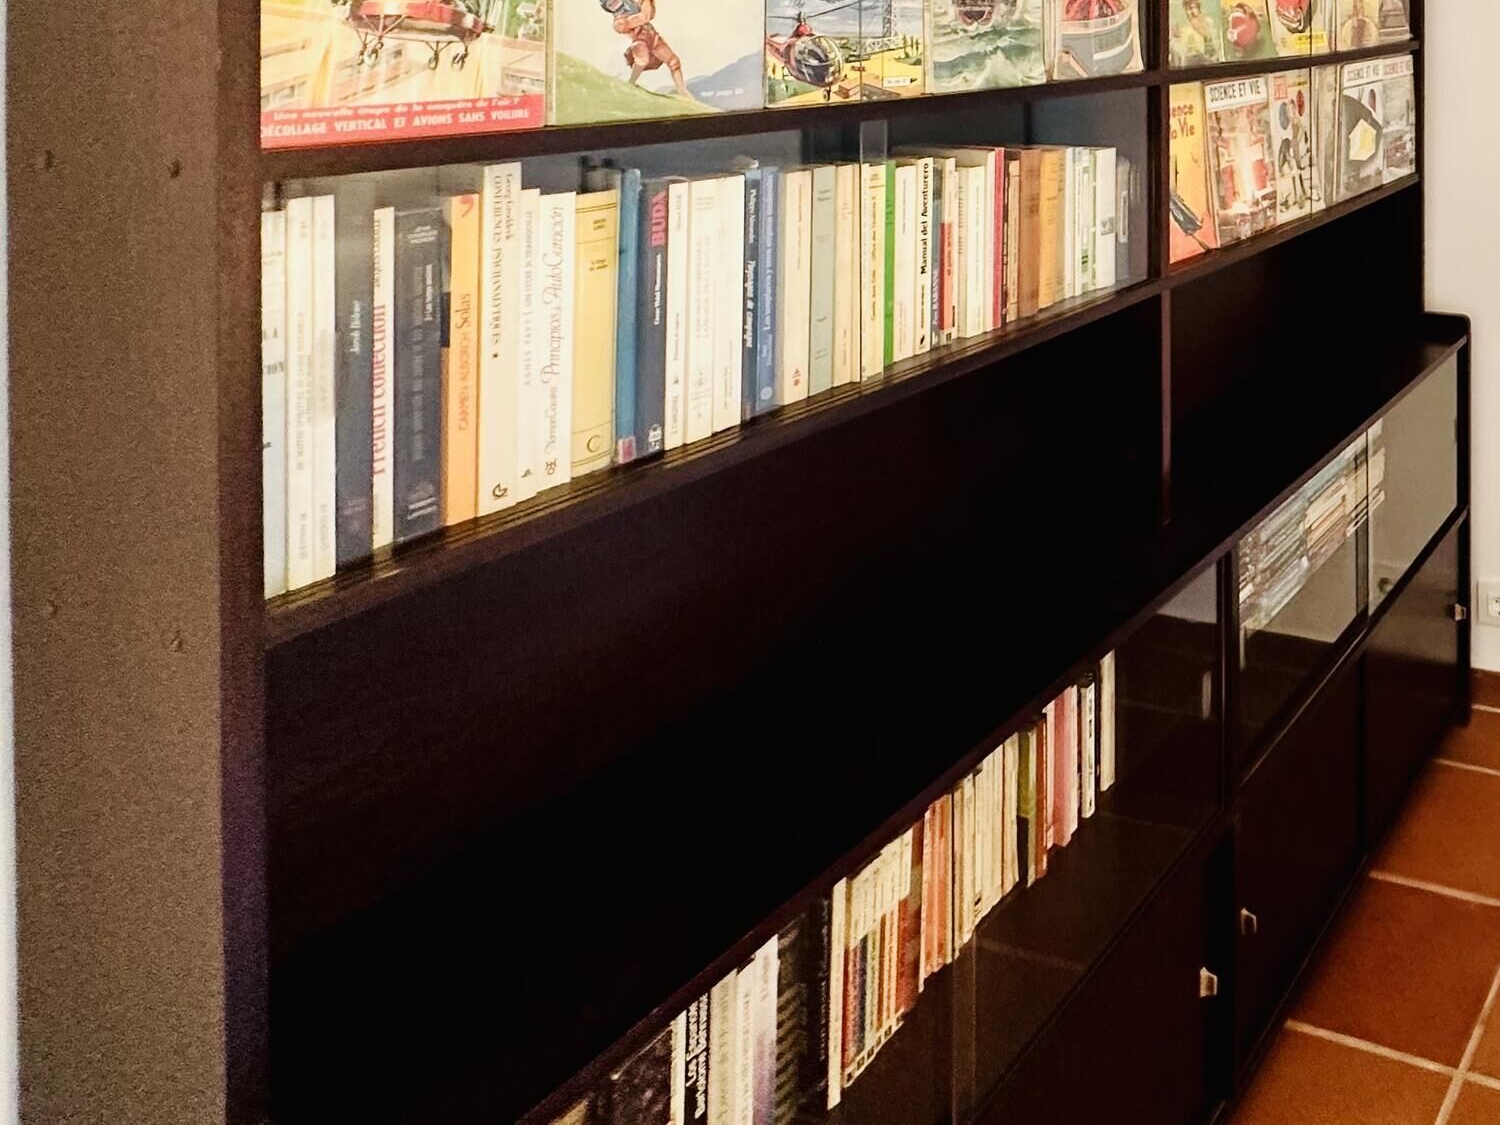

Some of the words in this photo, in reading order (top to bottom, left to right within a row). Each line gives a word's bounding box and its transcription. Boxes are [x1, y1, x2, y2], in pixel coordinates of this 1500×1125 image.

[1208, 83, 1237, 104] SCIENCE
[1238, 81, 1247, 97] ET
[1249, 79, 1261, 95] VIE
[334, 118, 388, 132] VERTICAL
[394, 116, 406, 128] ET
[412, 113, 453, 127] AVIONS
[458, 111, 486, 123] SANS
[490, 108, 530, 121] VOILURE
[1171, 103, 1195, 118] ence
[1177, 117, 1196, 138] Vie
[920, 162, 931, 219] Aventurero
[651, 190, 669, 248] BUDA
[920, 220, 930, 236] del
[919, 238, 930, 275] Manual
[454, 293, 472, 330] Solas
[540, 313, 566, 385] Principios
